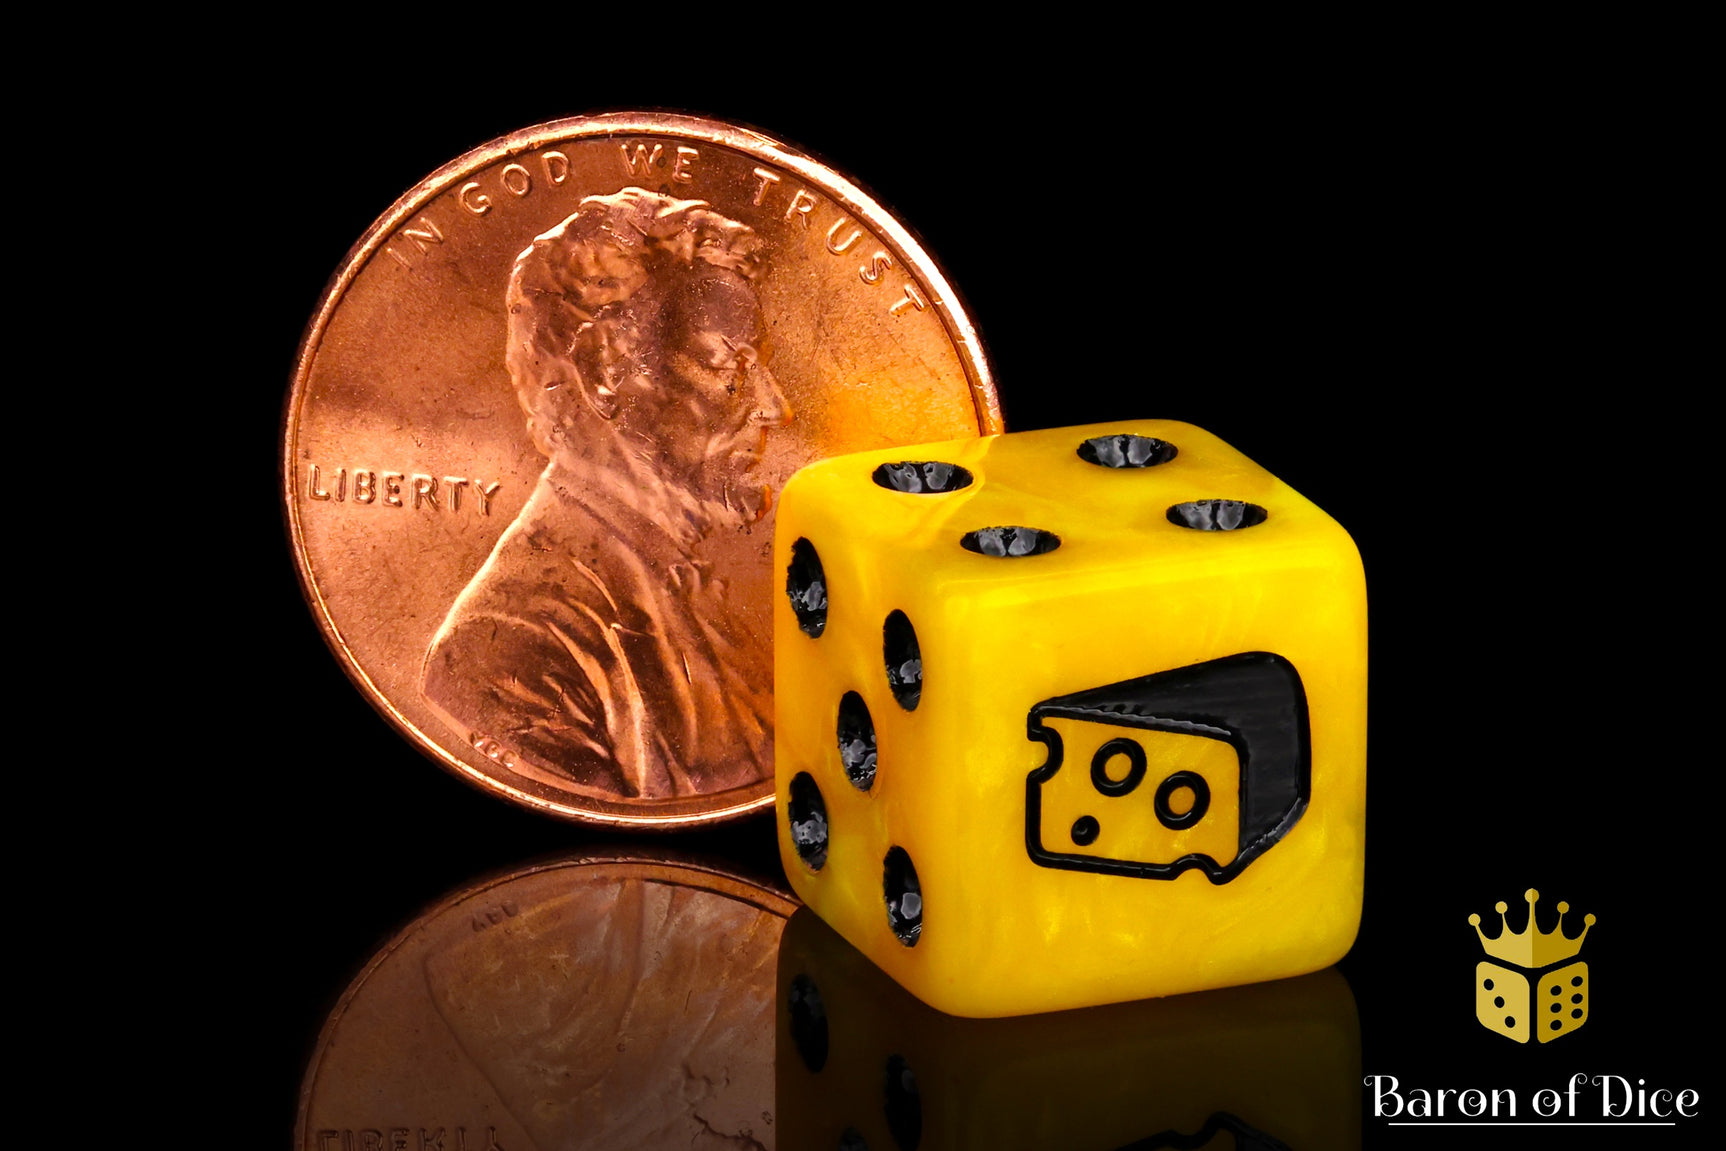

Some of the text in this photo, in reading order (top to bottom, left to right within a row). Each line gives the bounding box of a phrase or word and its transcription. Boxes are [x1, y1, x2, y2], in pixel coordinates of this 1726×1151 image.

[386, 144, 925, 316] IN GOD WE TRUST
[308, 463, 502, 517] LIBERTY
